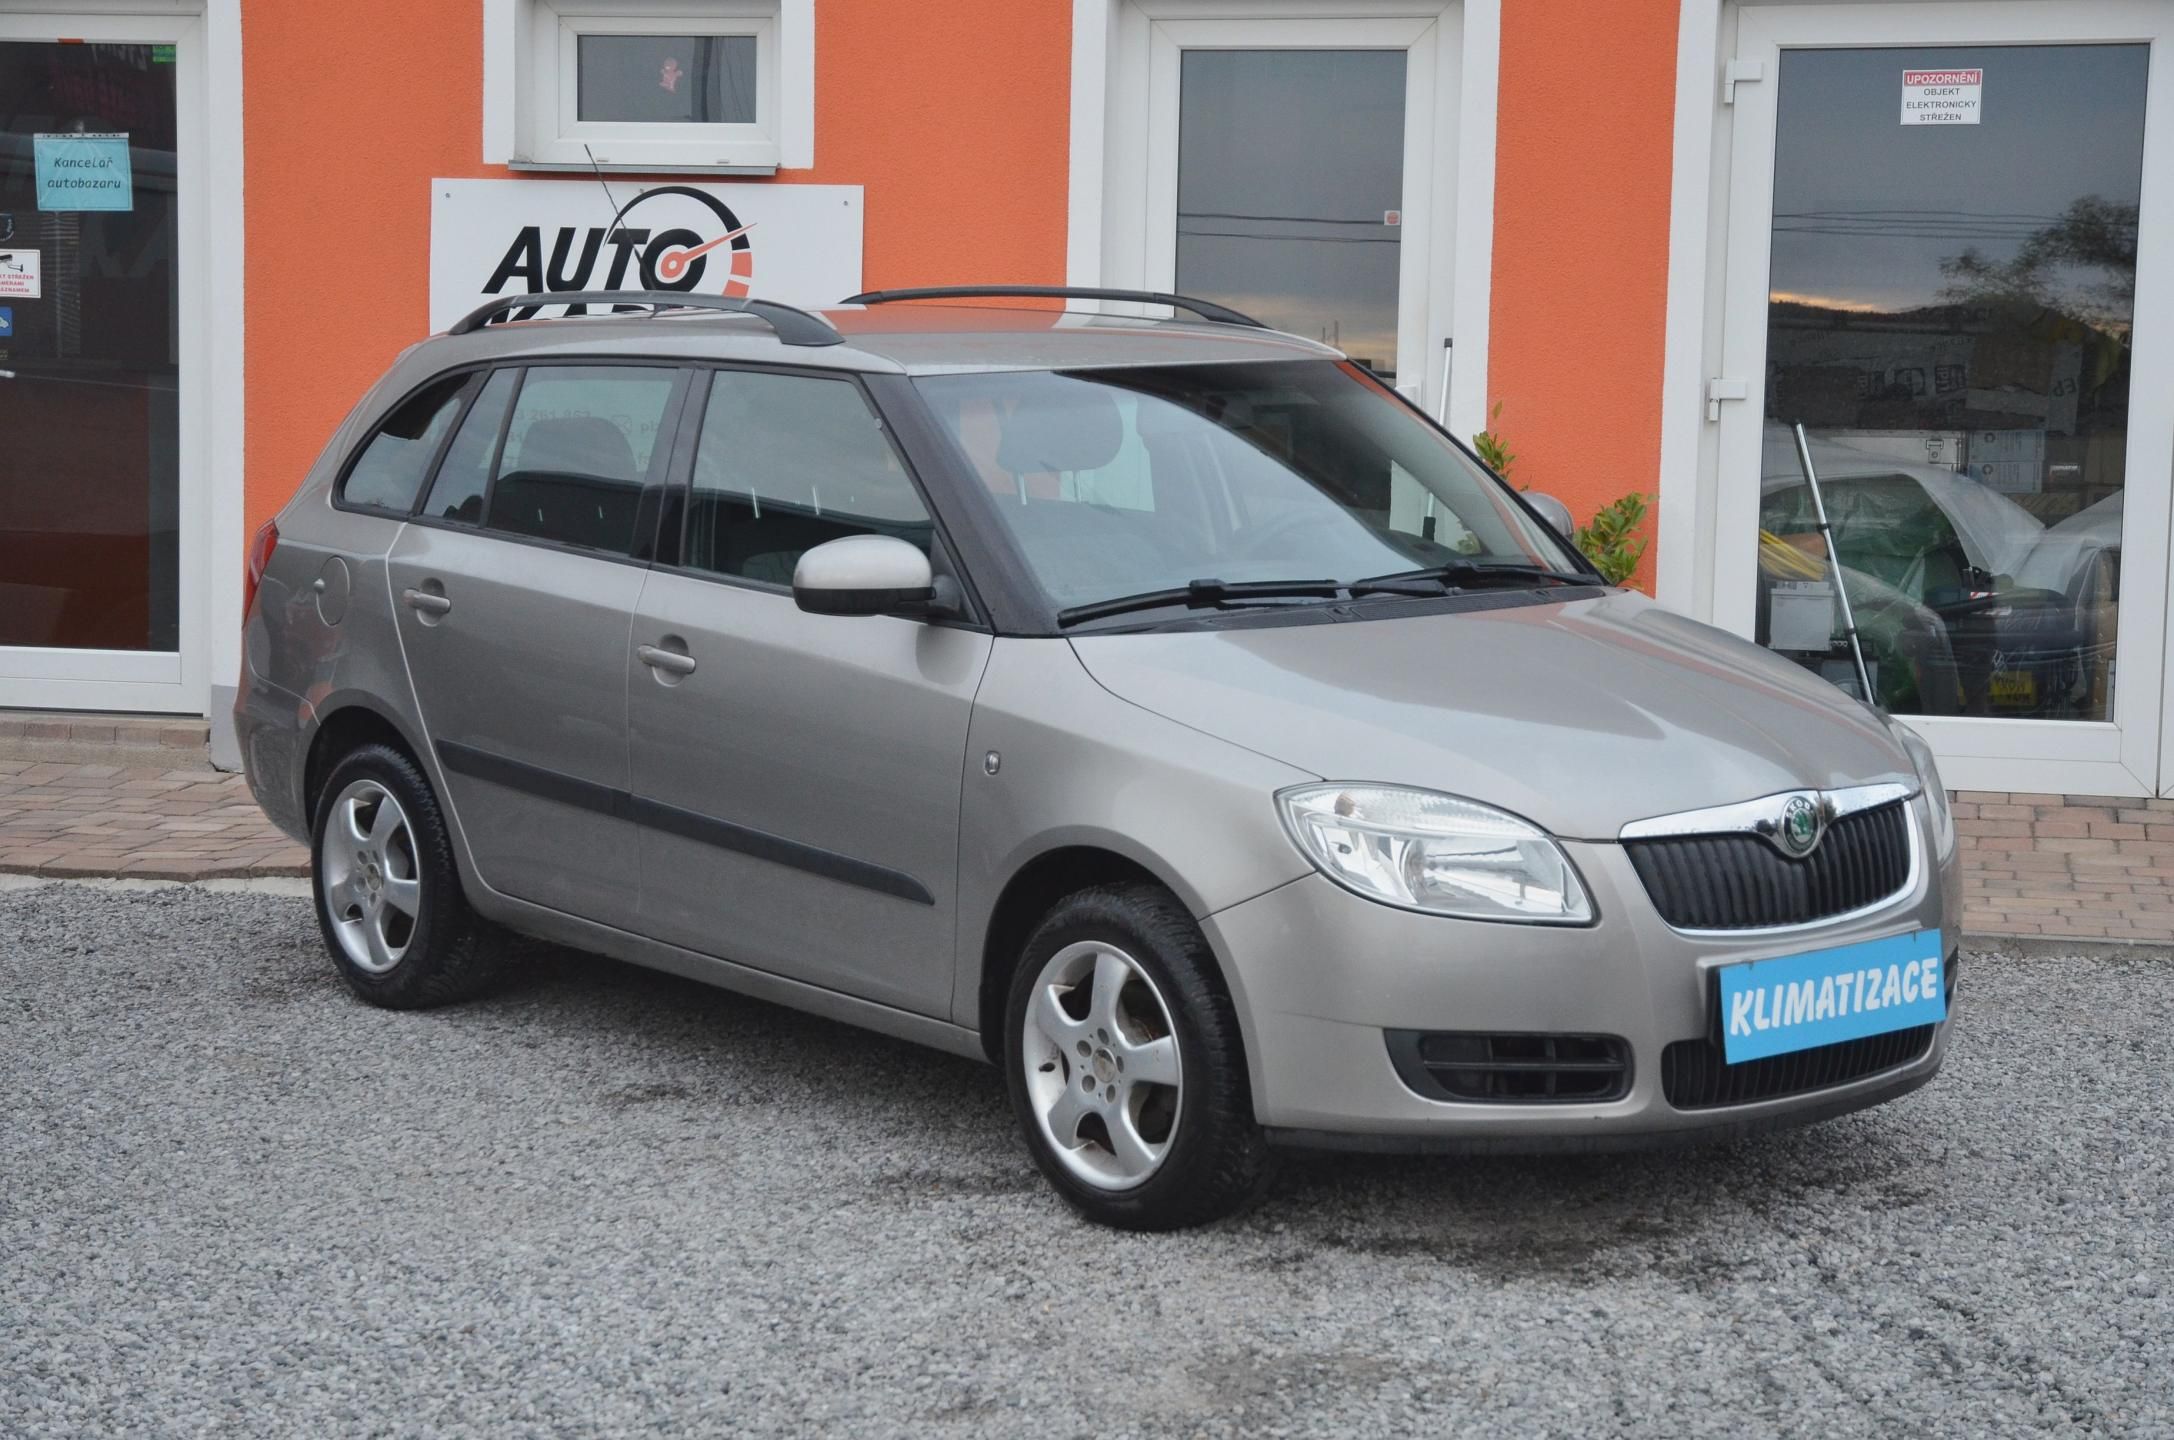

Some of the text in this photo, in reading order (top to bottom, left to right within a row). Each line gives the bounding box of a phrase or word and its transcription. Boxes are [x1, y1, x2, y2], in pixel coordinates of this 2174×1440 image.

[1907, 72, 1978, 84] UPOZORNĚNÍ
[1923, 88, 1961, 96] OBJEKT
[1906, 100, 1977, 109] ELEKTRONICKY
[1919, 113, 1962, 121] STŘEŽEN
[47, 177, 121, 189] autobazaru
[481, 226, 708, 294] AUTO
[1730, 956, 1938, 1037] KLIMATIZACE
